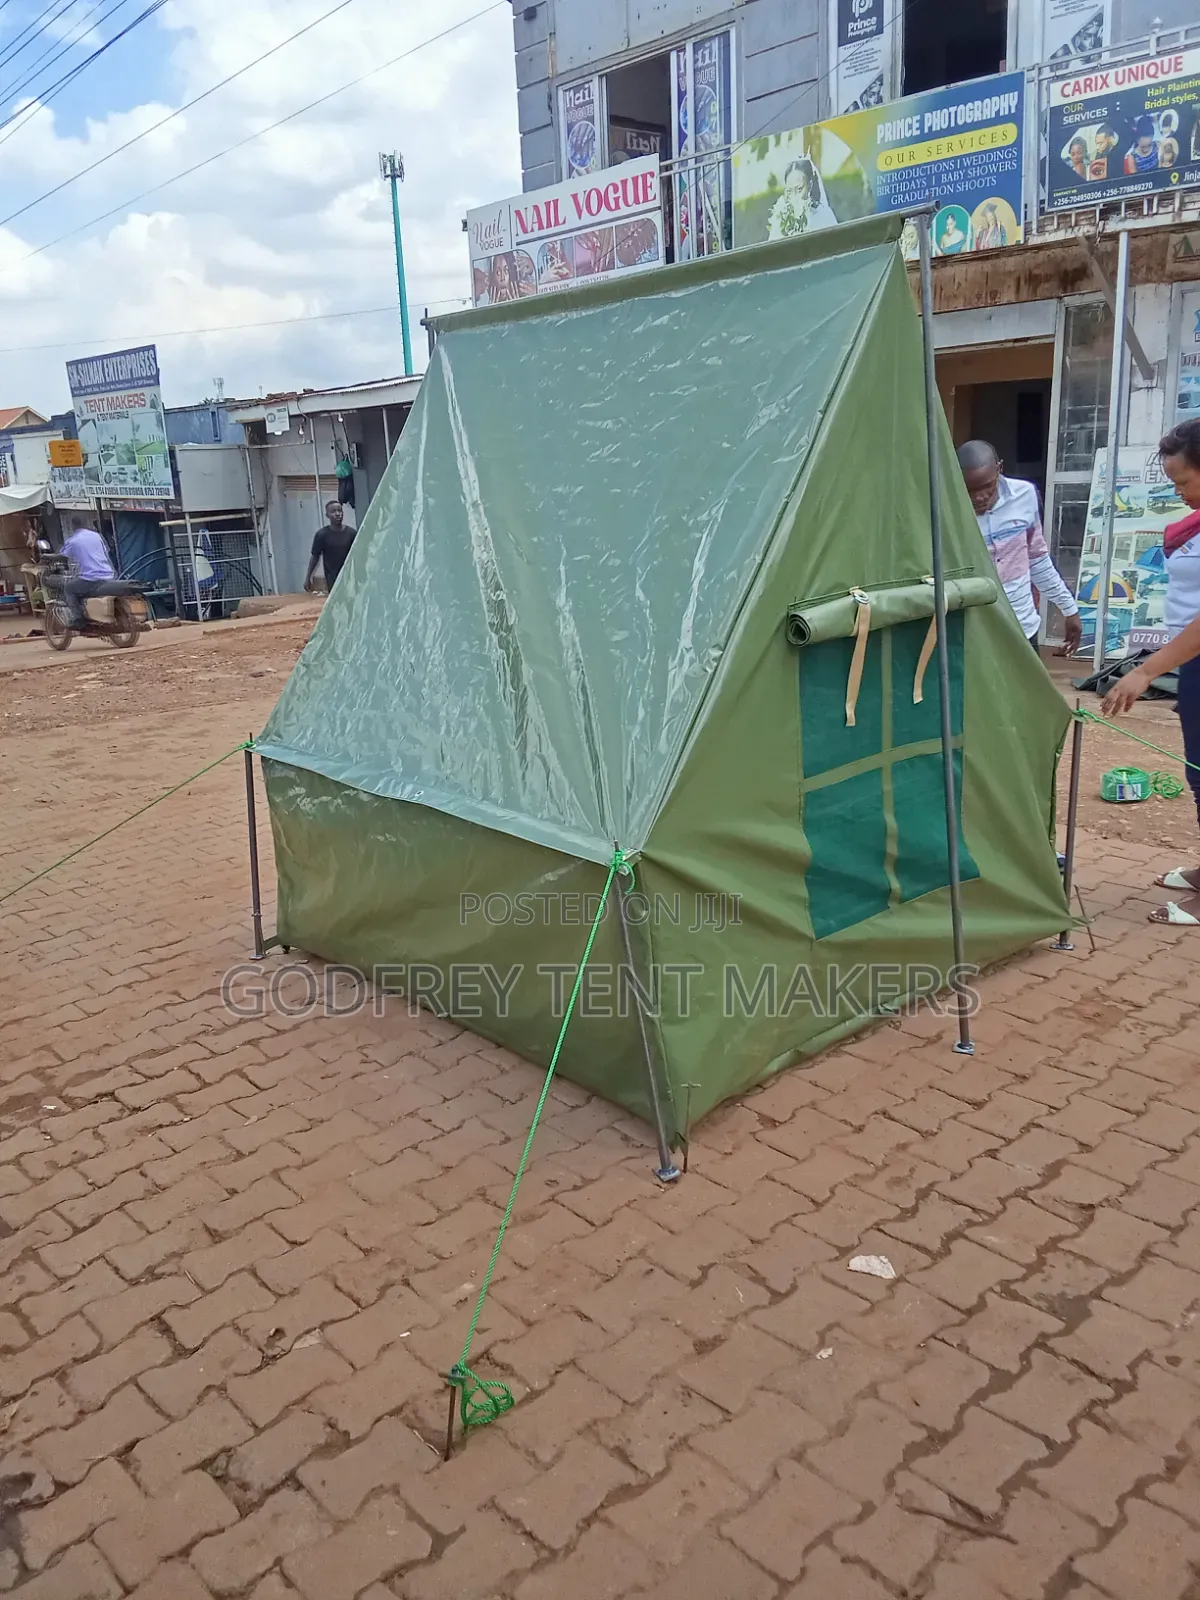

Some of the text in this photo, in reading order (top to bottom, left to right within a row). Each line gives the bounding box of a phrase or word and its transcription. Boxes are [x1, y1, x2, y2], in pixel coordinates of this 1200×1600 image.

[849, 17, 877, 32] Prince
[1061, 56, 1183, 98] CARIX UNIQUE
[565, 84, 595, 108] Nail
[1145, 92, 1198, 110] Bridal styles,
[1147, 85, 1166, 97] Hair
[566, 104, 594, 124] VOGUE
[876, 92, 1018, 144] PRINCE PHOTOGRAPHY
[1062, 102, 1084, 114] OUR
[1062, 107, 1108, 125] SERVICES
[884, 130, 1008, 166] OUR SERVICES
[877, 160, 954, 185] INTRODUCTIONS
[962, 148, 1018, 167] WEDDINGS
[877, 178, 926, 196] BIRTHDAYS
[942, 170, 966, 183] BABY
[968, 160, 1017, 178] SHOWERS
[891, 176, 997, 205] GRADUATION SHOOTS
[514, 171, 657, 236] NAIL VOGUE
[472, 209, 506, 246] Nail
[479, 237, 504, 250] VOGUE
[102, 349, 156, 382] ENTERPRISES
[84, 392, 146, 414] TENT MAKERS
[1132, 633, 1160, 643] 0770
